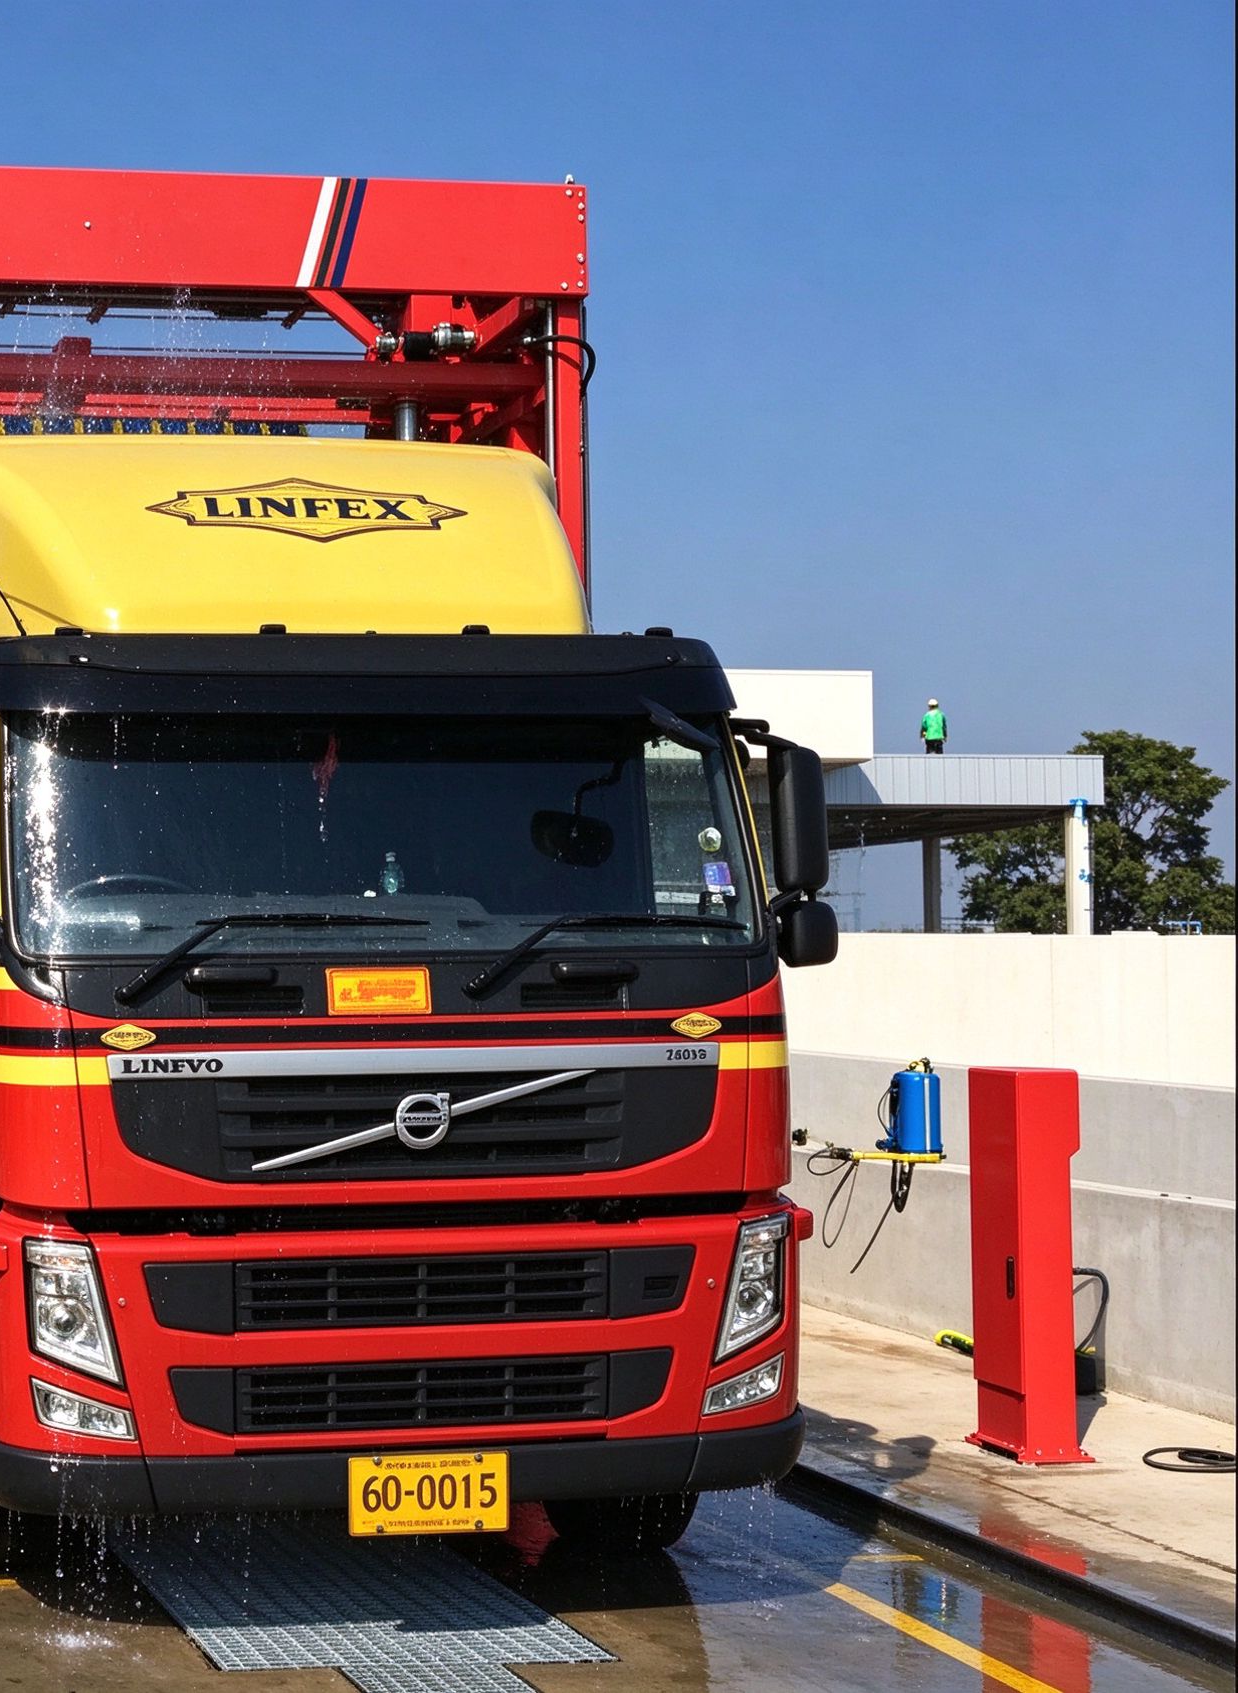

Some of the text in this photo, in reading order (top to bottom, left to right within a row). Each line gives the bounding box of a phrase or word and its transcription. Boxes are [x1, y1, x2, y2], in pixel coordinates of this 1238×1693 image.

[203, 496, 419, 521] LINFEX
[120, 1058, 224, 1074] LINFVO
[362, 1472, 498, 1513] 60-0015
